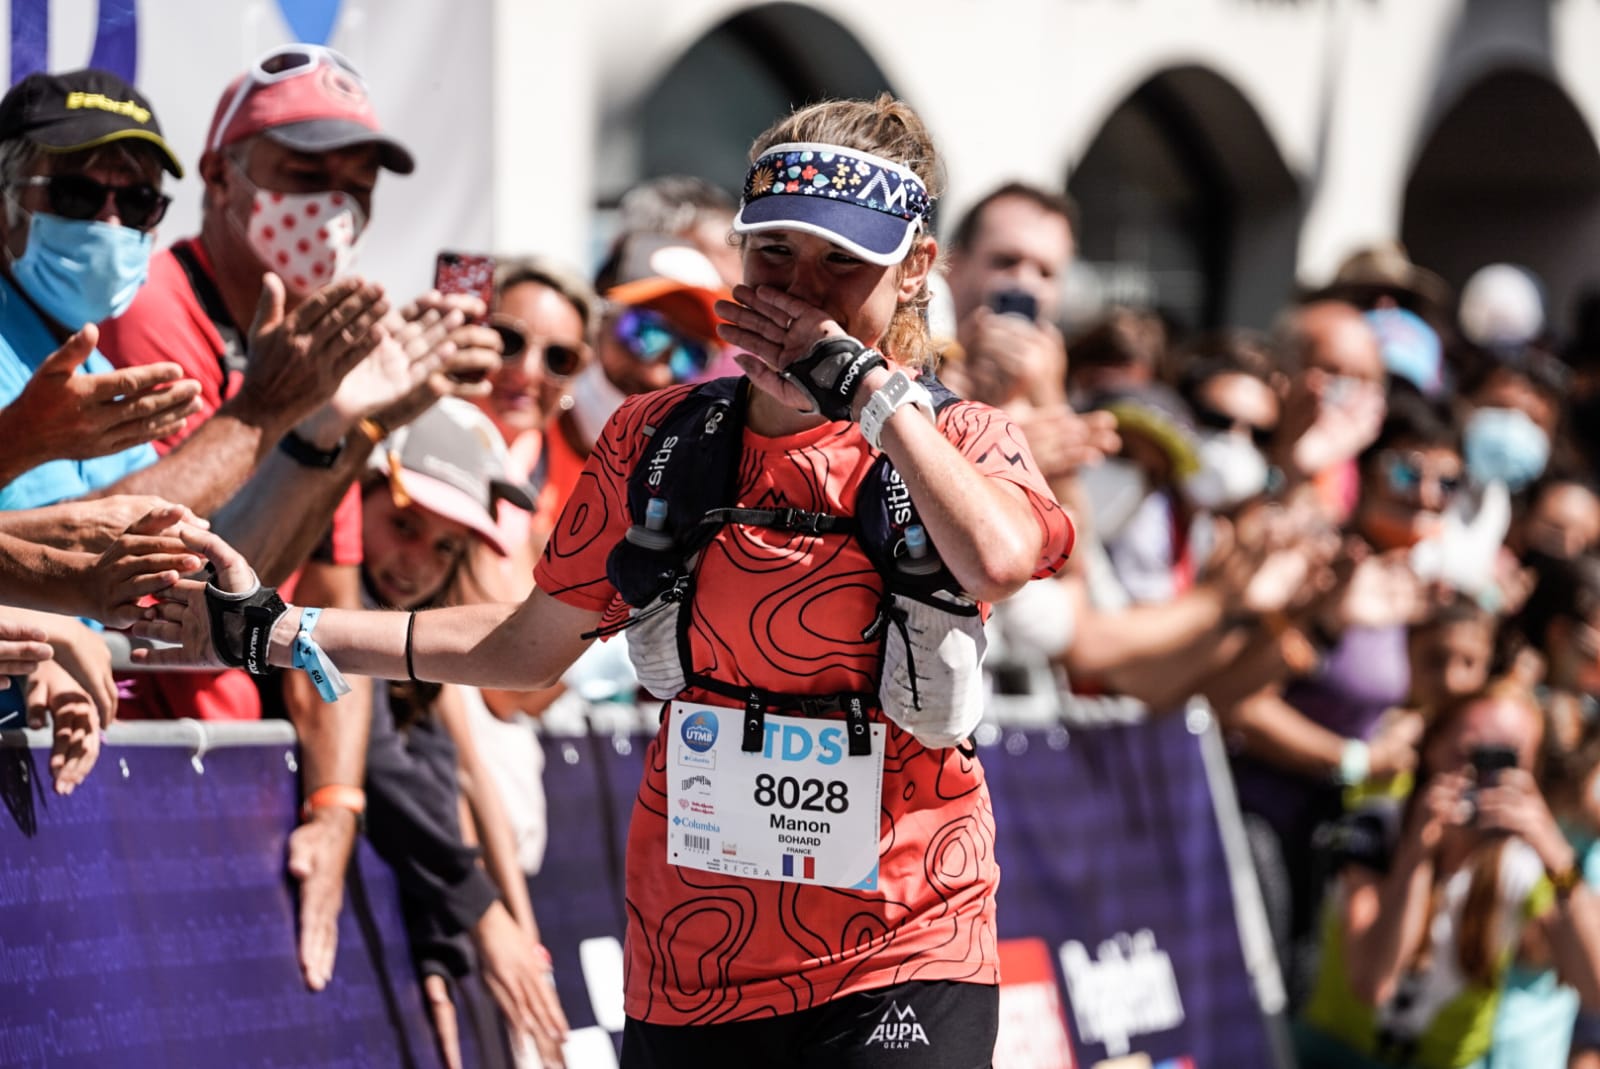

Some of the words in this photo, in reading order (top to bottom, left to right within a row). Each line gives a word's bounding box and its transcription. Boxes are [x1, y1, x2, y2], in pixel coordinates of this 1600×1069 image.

[685, 730, 714, 743] UTMB
[763, 721, 843, 766] TDS
[753, 773, 850, 814] 8028
[681, 816, 721, 833] Columbia
[769, 813, 831, 834] Manon
[778, 834, 821, 847] BOHARD
[786, 846, 812, 855] FRANCE
[865, 1022, 930, 1046] AUPA
[883, 1041, 911, 1049] GEAR
